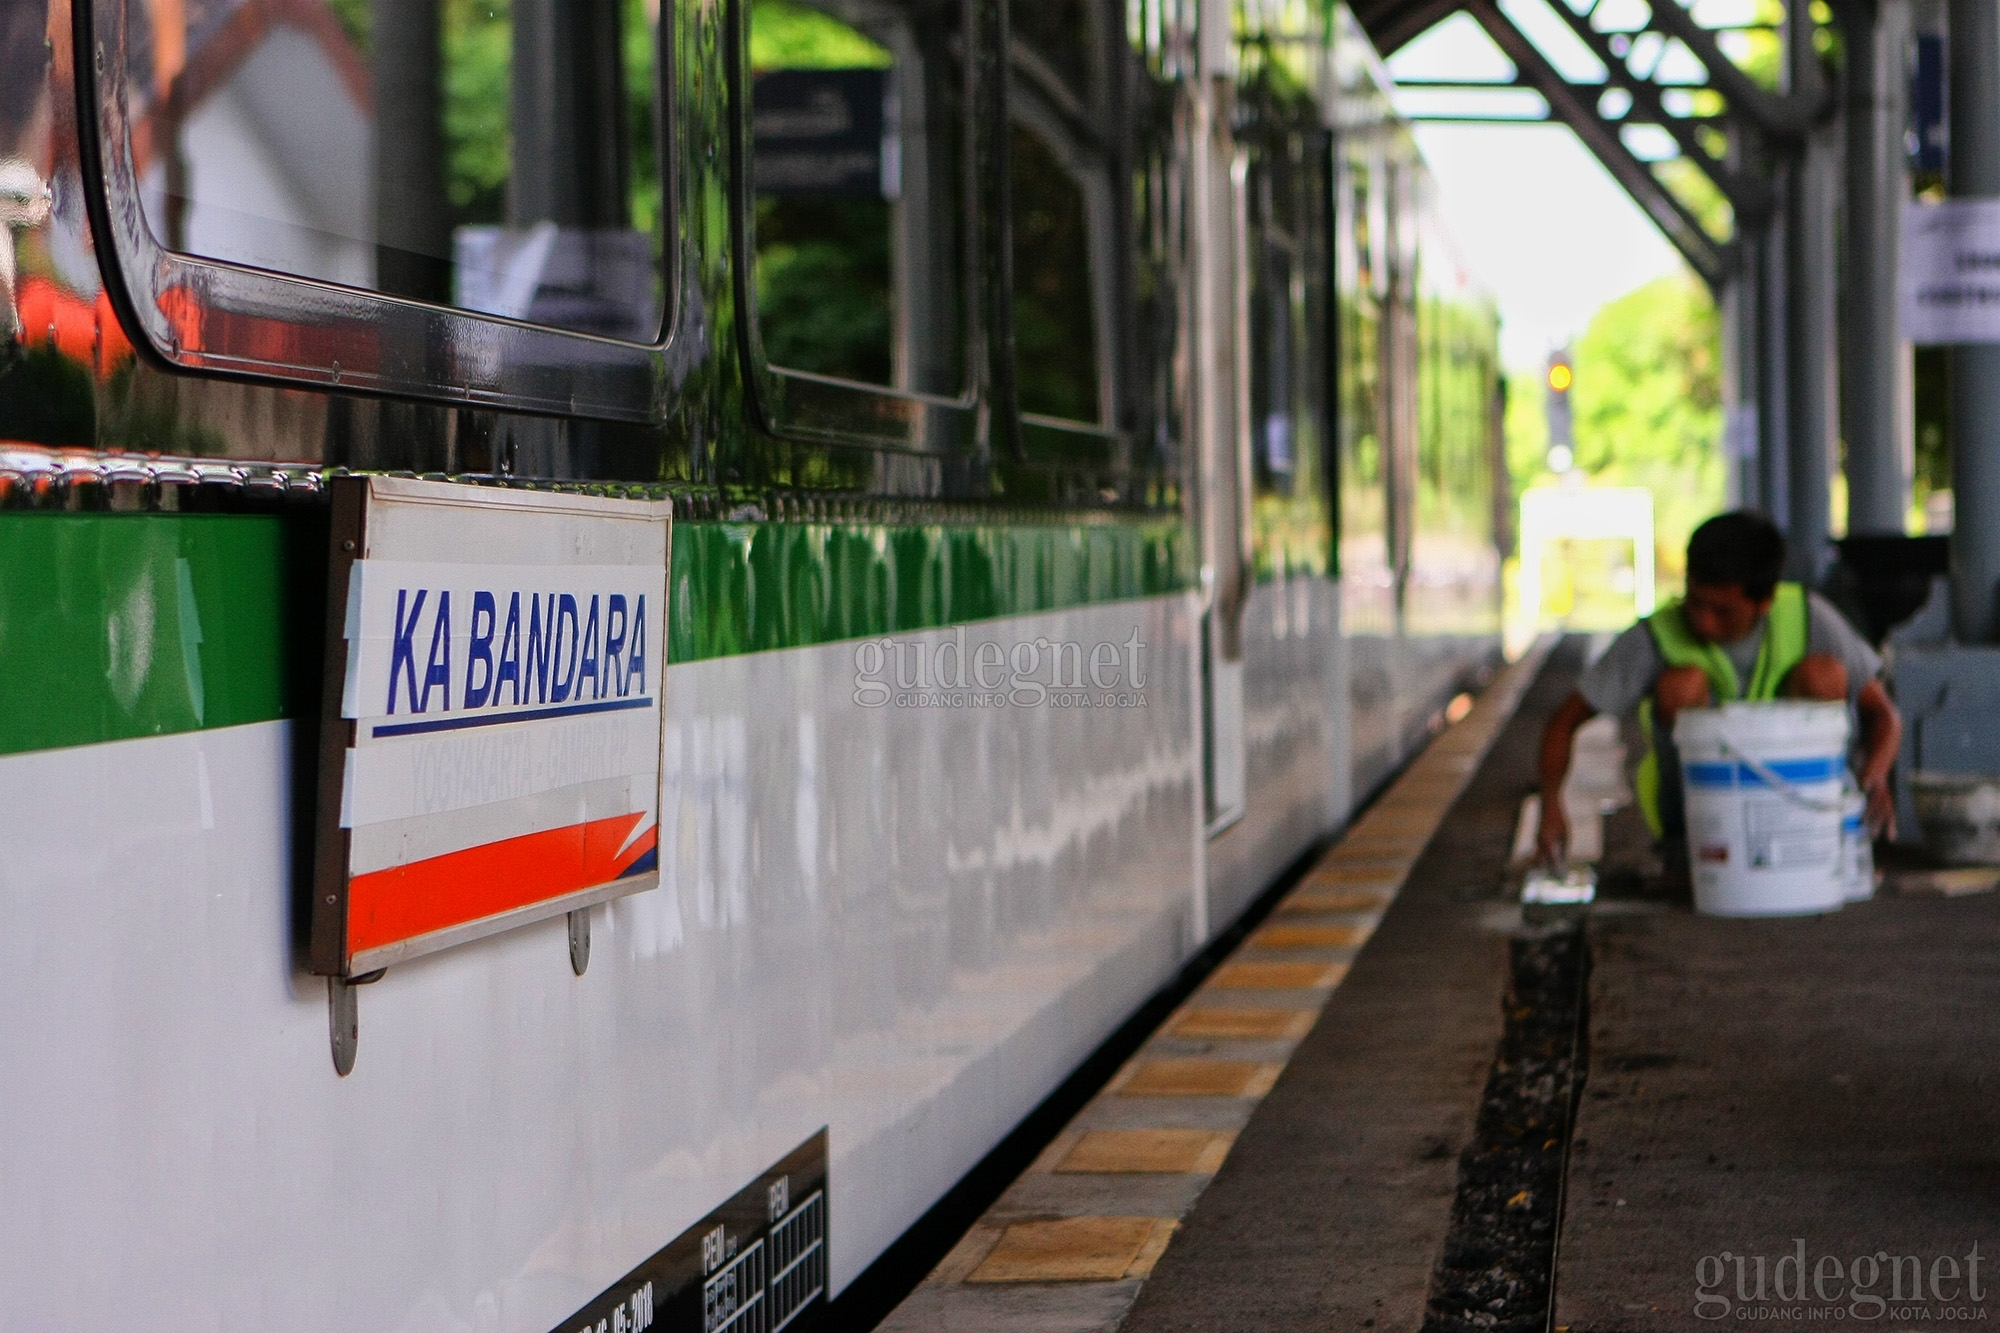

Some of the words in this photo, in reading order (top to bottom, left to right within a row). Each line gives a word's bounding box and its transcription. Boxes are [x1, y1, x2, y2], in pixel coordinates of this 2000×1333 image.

[387, 588, 450, 715] KA
[464, 590, 646, 710] BANDARA
[411, 730, 532, 815] YOGYAKARTA
